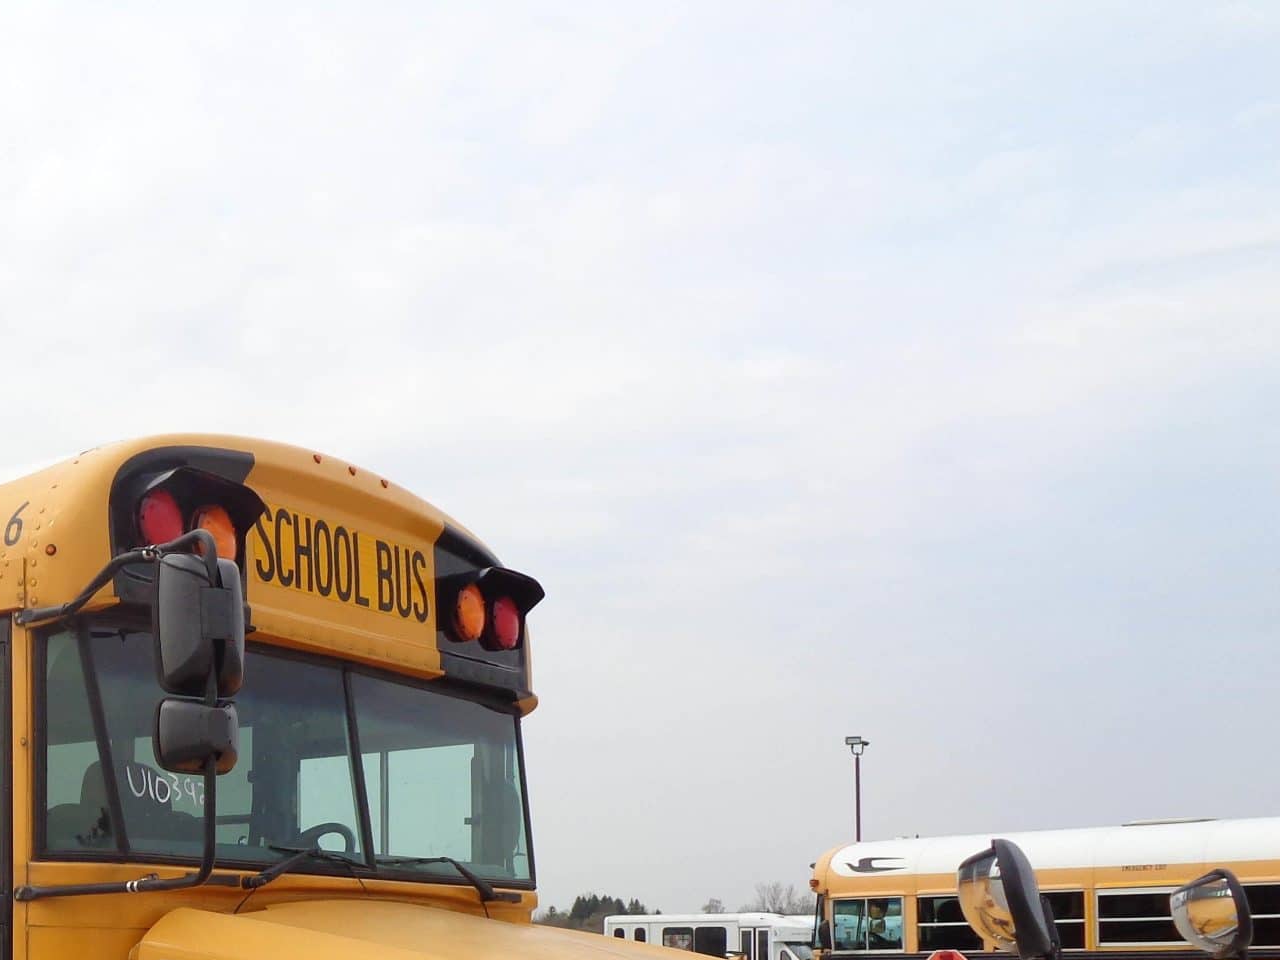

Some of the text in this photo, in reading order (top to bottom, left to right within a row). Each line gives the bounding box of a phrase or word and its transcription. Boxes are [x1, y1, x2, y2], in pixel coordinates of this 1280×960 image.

[4, 500, 30, 547] 6
[254, 504, 429, 623] SCHOOL BUS
